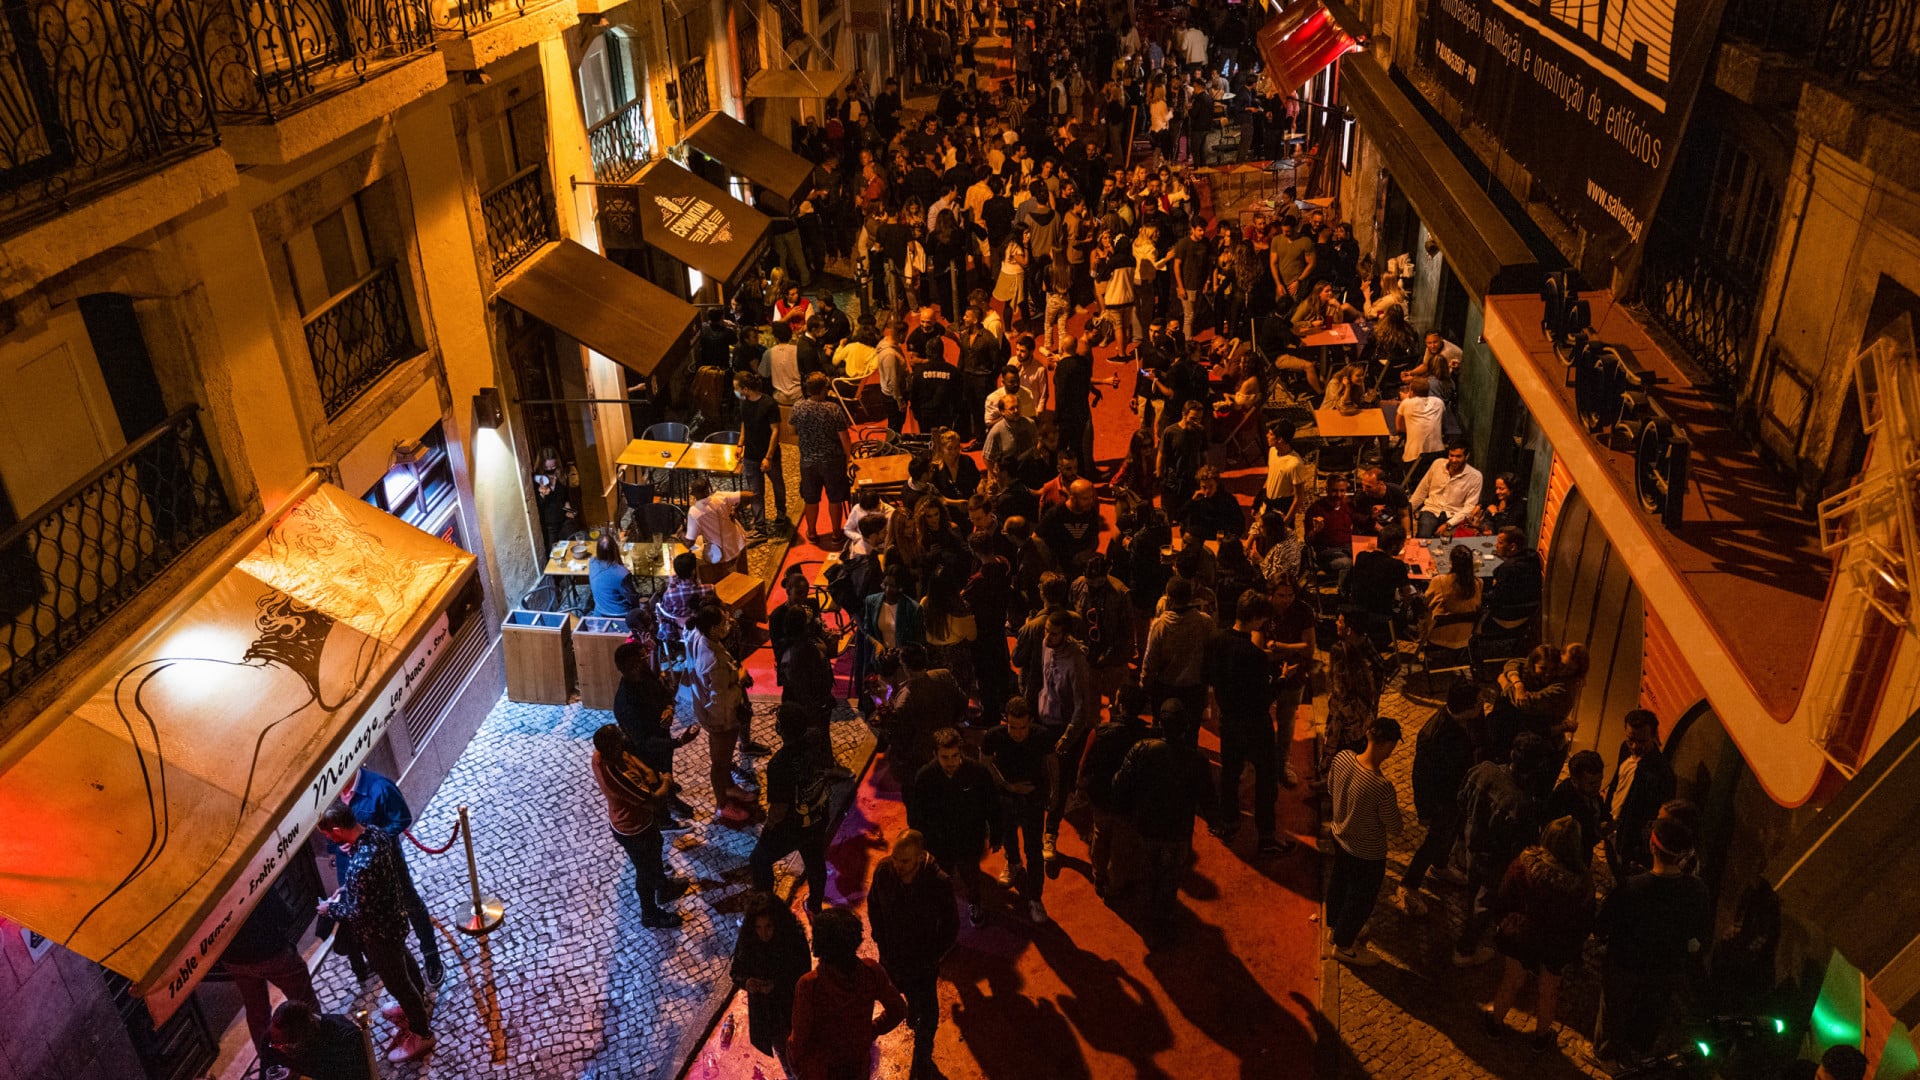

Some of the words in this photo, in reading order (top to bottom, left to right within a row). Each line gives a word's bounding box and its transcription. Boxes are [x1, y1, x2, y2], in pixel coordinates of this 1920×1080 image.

[1523, 48, 1531, 72] e
[1587, 87, 1601, 126] de
[391, 687, 402, 707] Lap
[405, 658, 425, 688] Dance
[312, 715, 379, 808] Ménage
[168, 956, 198, 998] Table
[200, 910, 233, 957] Dance
[248, 857, 276, 897] Erotic
[277, 824, 299, 859] Show
